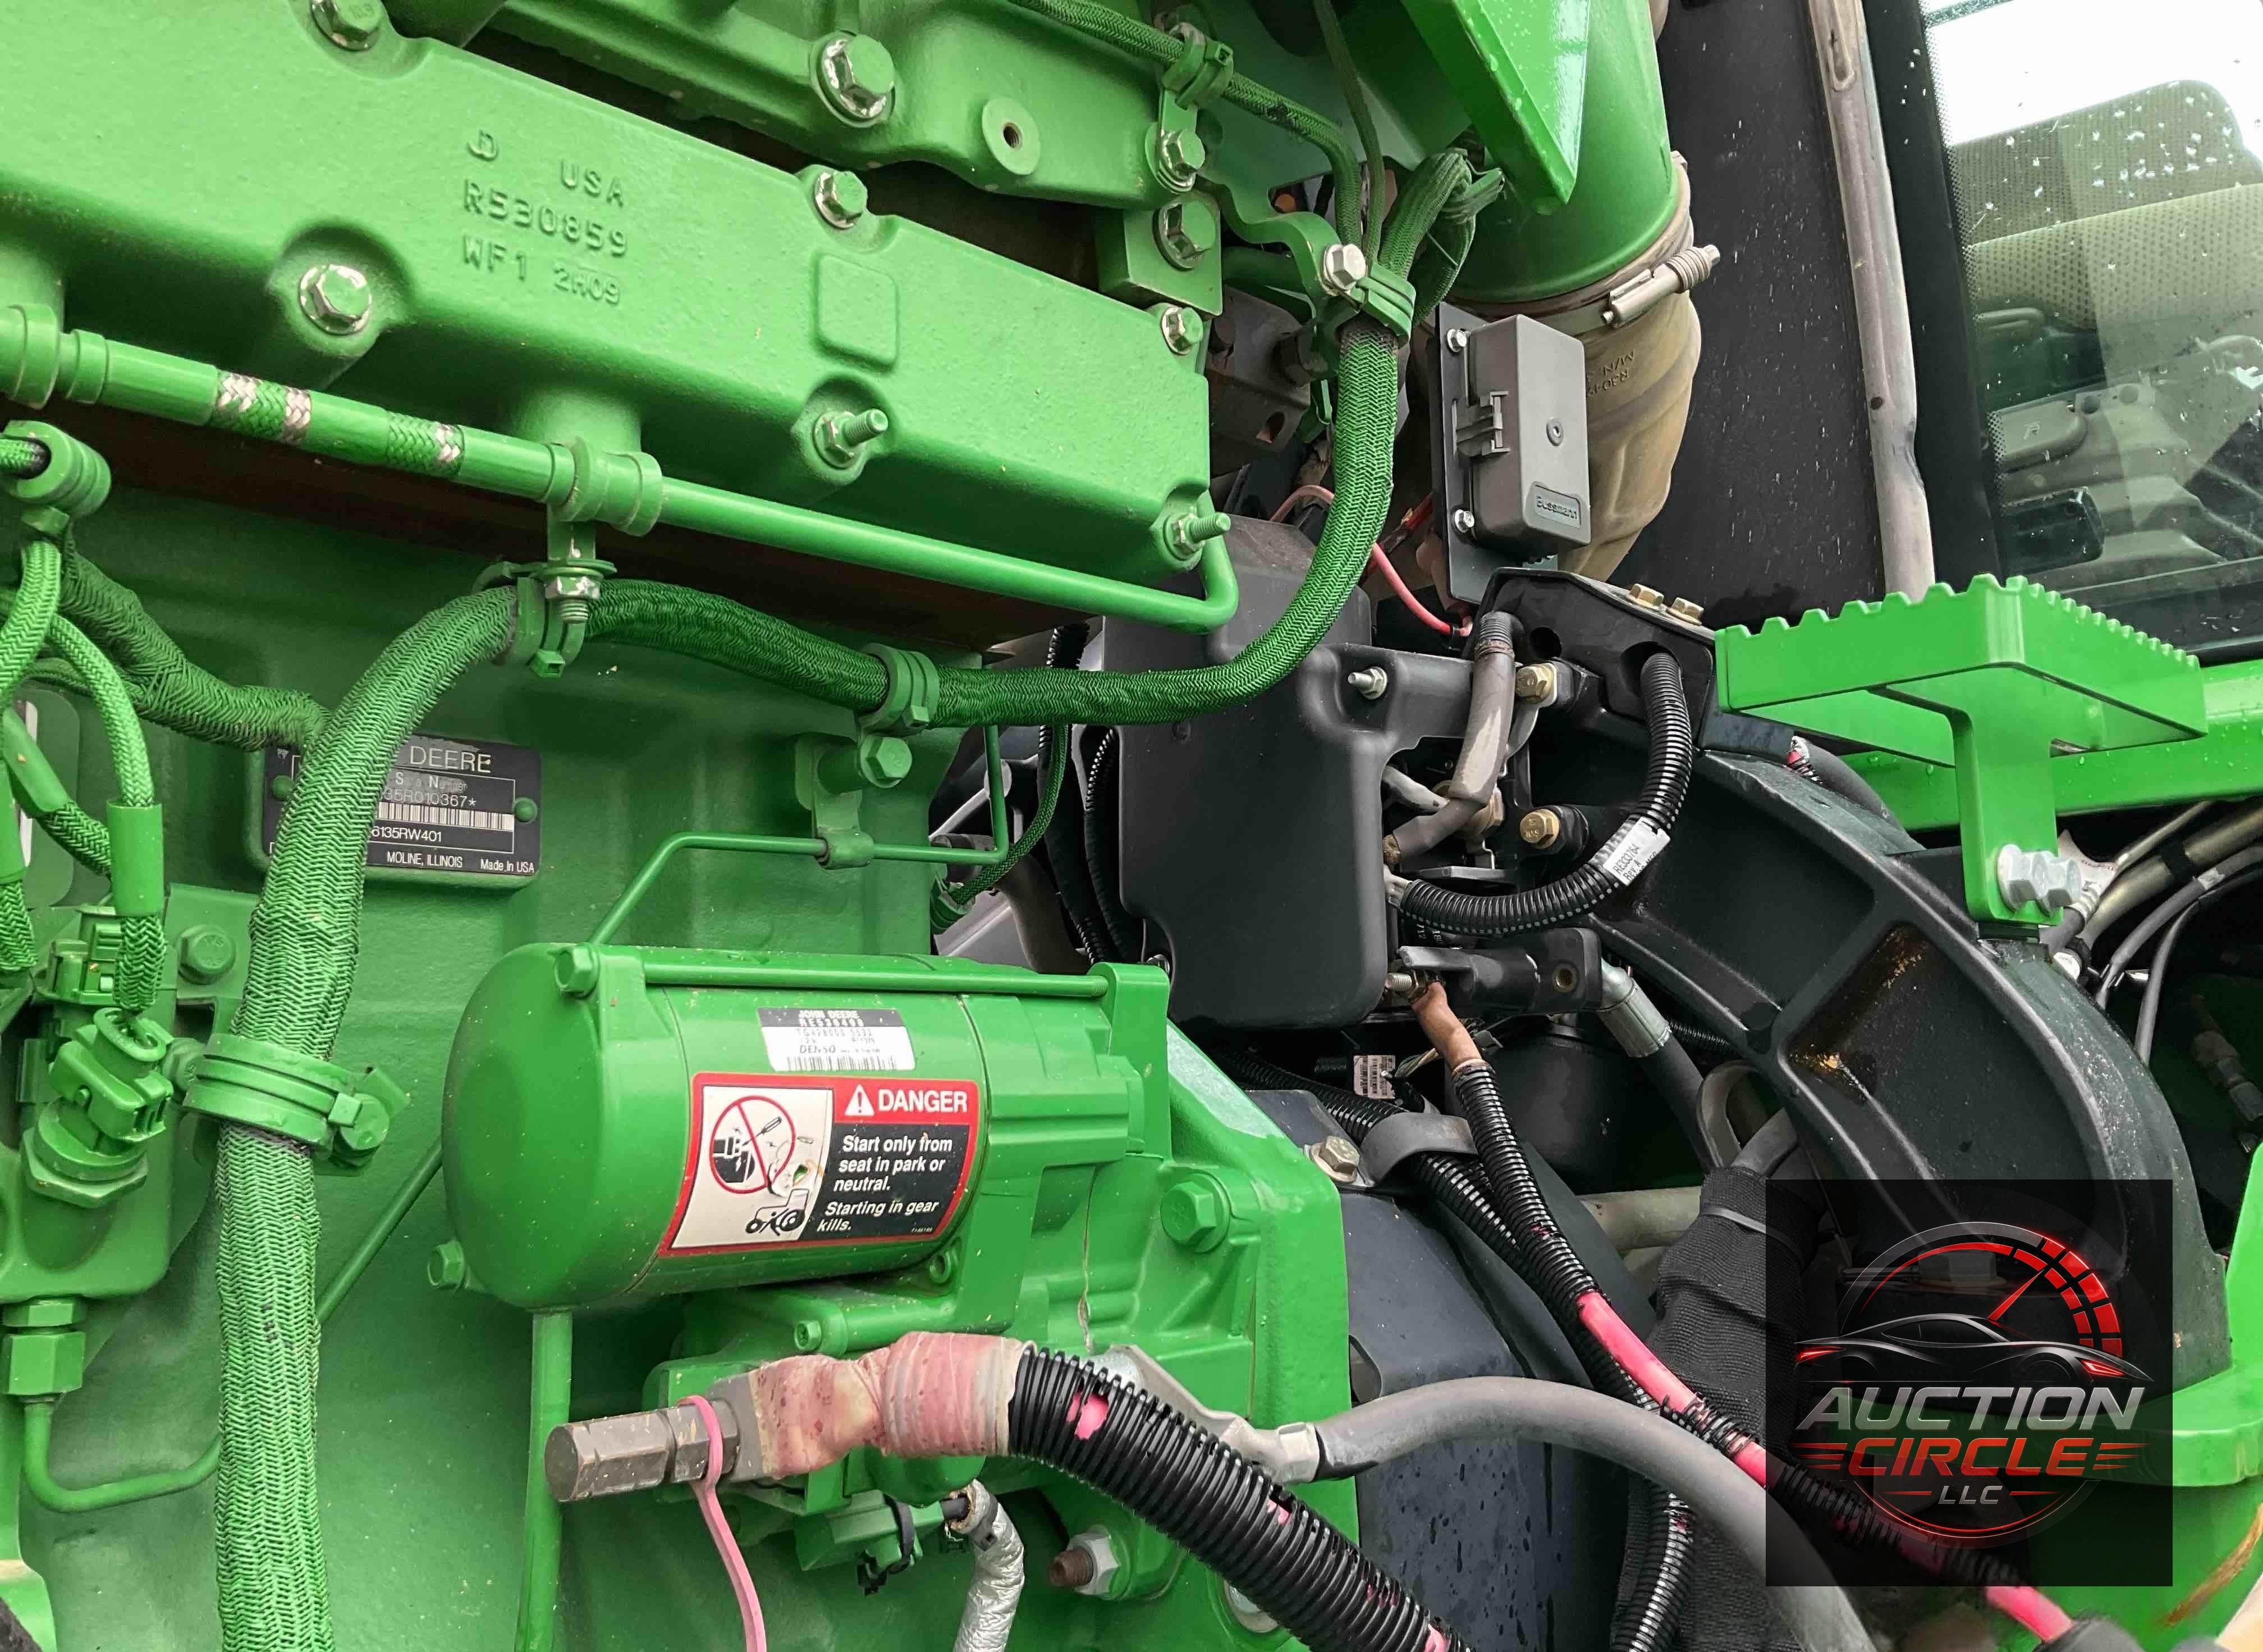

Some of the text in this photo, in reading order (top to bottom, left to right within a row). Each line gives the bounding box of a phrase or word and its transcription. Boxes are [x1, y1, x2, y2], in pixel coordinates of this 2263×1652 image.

[560, 159, 624, 208] USA
[463, 178, 627, 259] R530859
[410, 745, 492, 773] DEERE
[387, 851, 423, 866] MOLINE,
[427, 853, 463, 869] ILLINOIS
[480, 858, 503, 871] Made
[516, 862, 534, 873] USA
[878, 1089, 968, 1113] DANGER
[842, 1135, 952, 1156] Start only from
[839, 1156, 946, 1175] seat in park or
[833, 1176, 891, 1192] neutral.
[825, 1201, 940, 1217] Starting in gear
[817, 1218, 852, 1232] kills.
